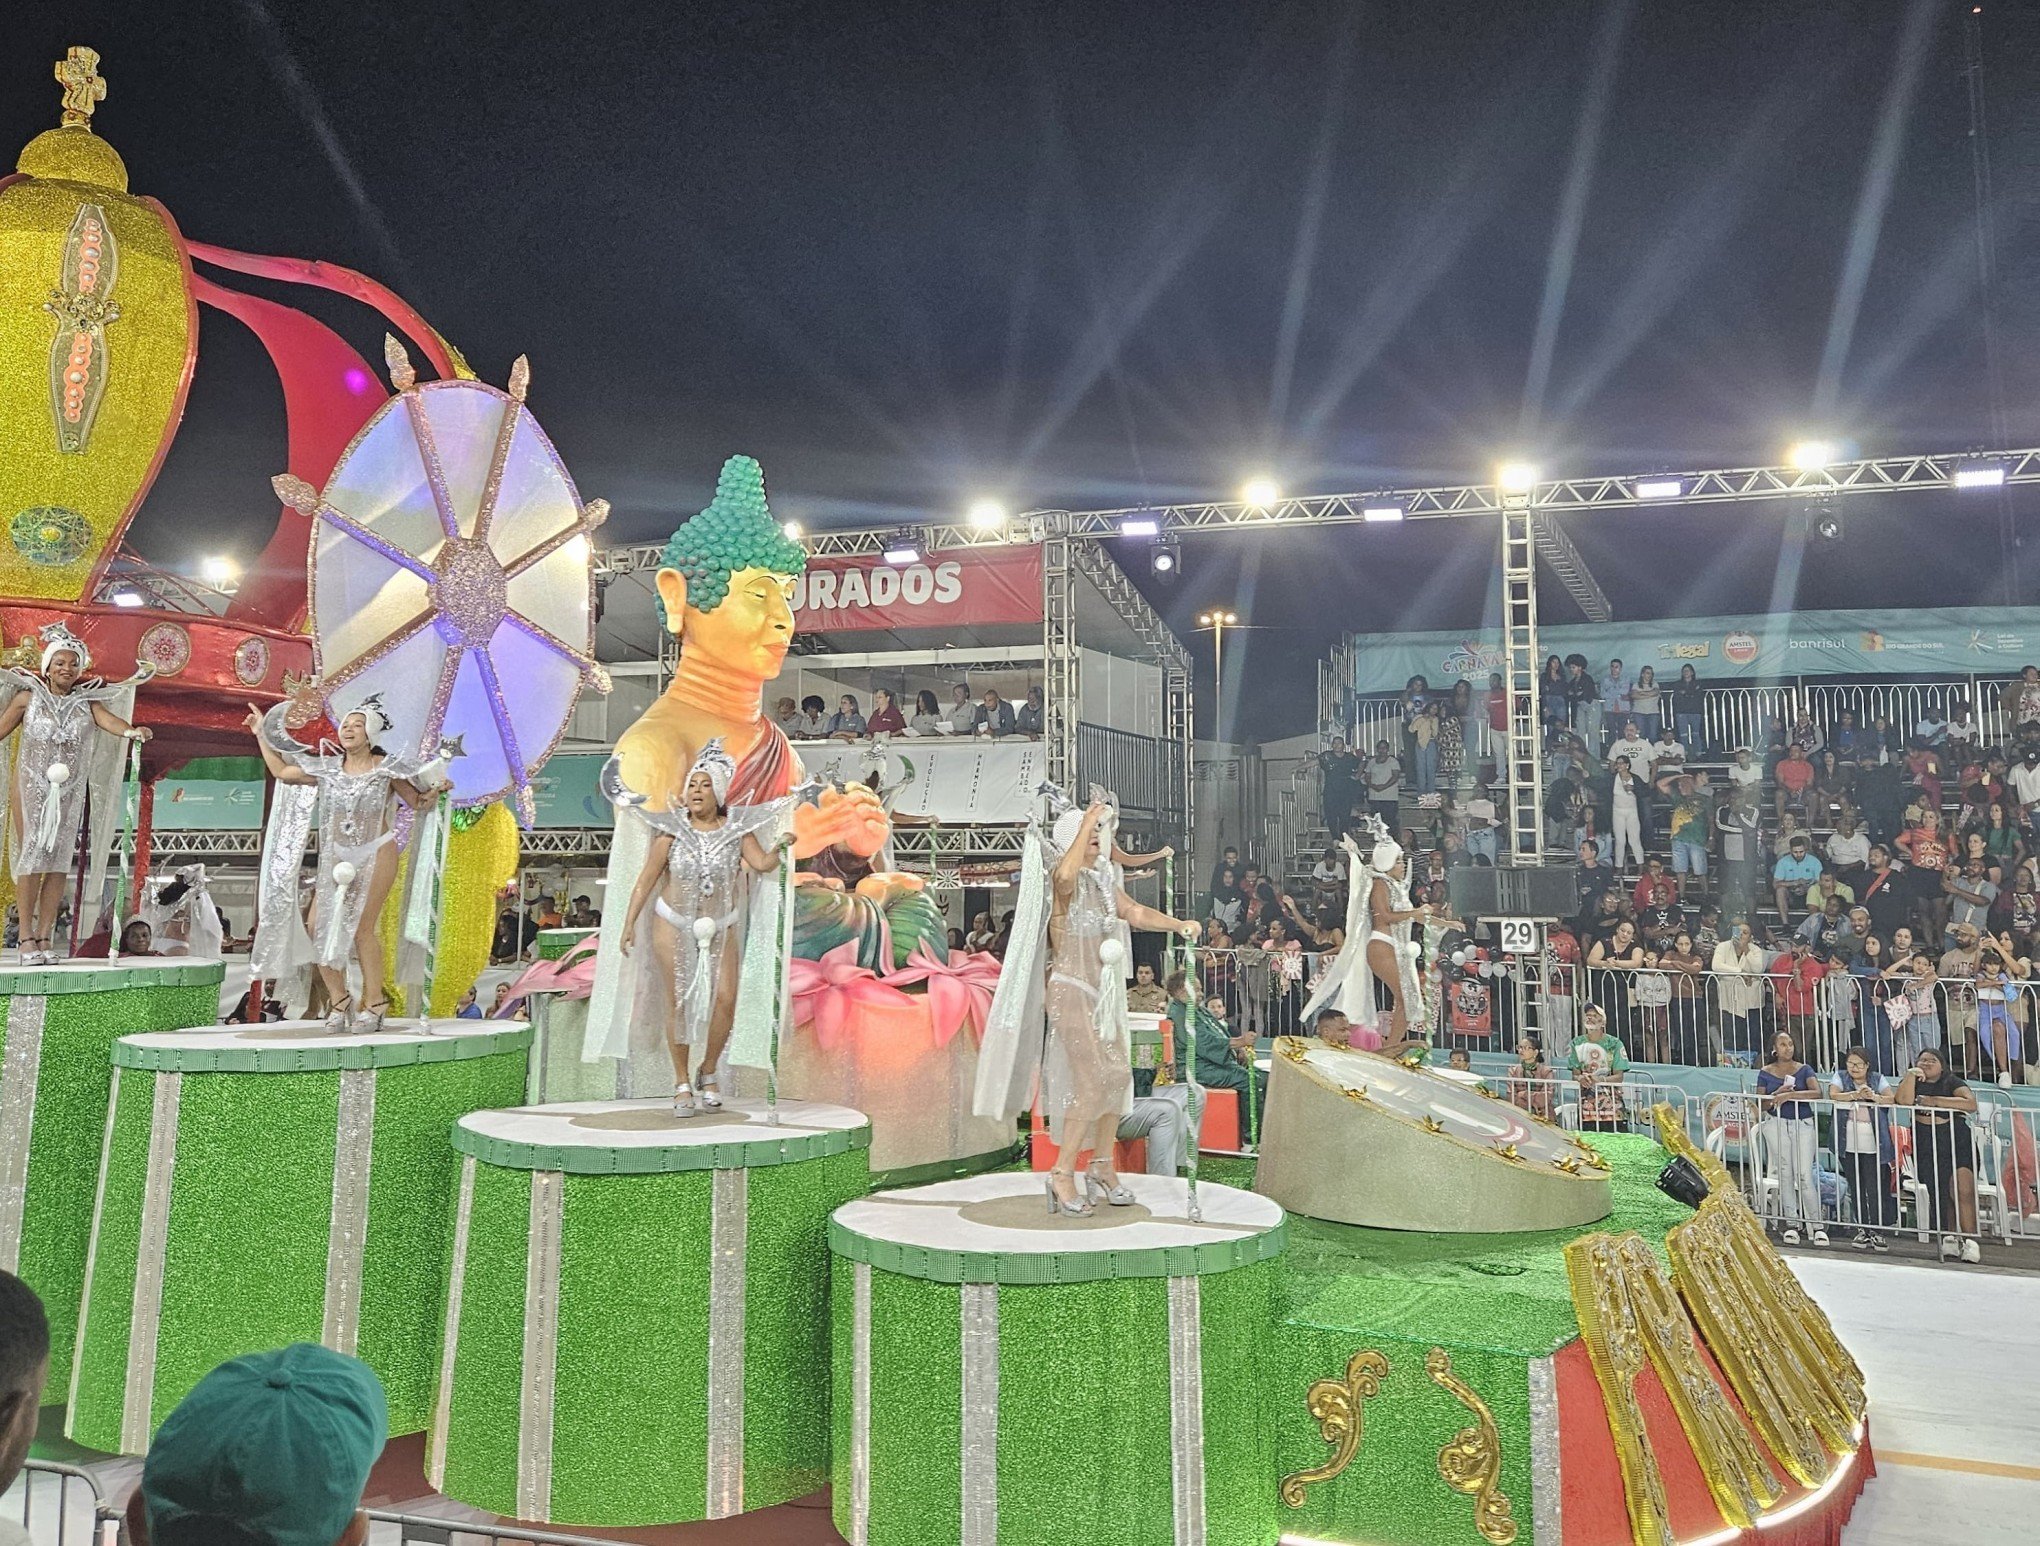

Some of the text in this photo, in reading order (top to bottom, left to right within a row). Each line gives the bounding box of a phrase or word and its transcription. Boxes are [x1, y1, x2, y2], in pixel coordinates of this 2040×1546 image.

[1789, 638, 1846, 649] banrisul
[1462, 669, 1490, 681] 2025
[1504, 922, 1532, 946] 29
[1715, 1110, 1746, 1120] AMSTE
